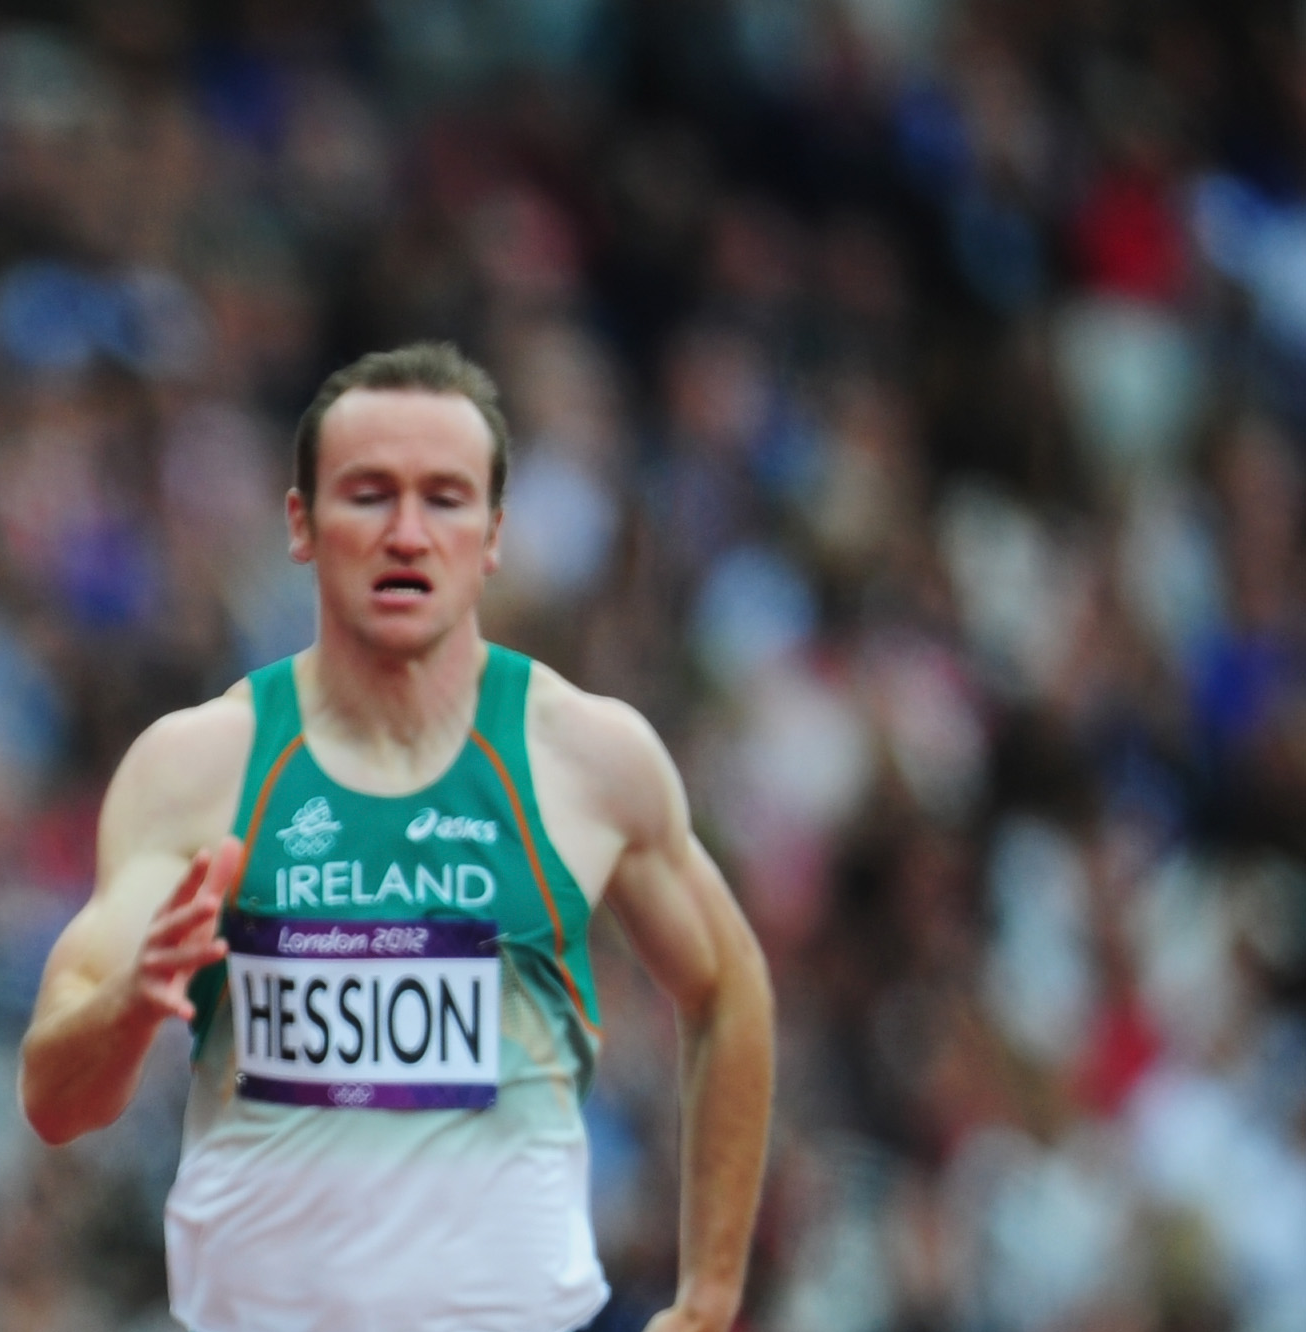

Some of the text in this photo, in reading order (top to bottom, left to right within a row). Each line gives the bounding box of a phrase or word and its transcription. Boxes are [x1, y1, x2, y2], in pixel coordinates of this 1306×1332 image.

[275, 859, 498, 909] IRELAND
[277, 926, 430, 954] London 2012
[243, 972, 482, 1064] HESSION
